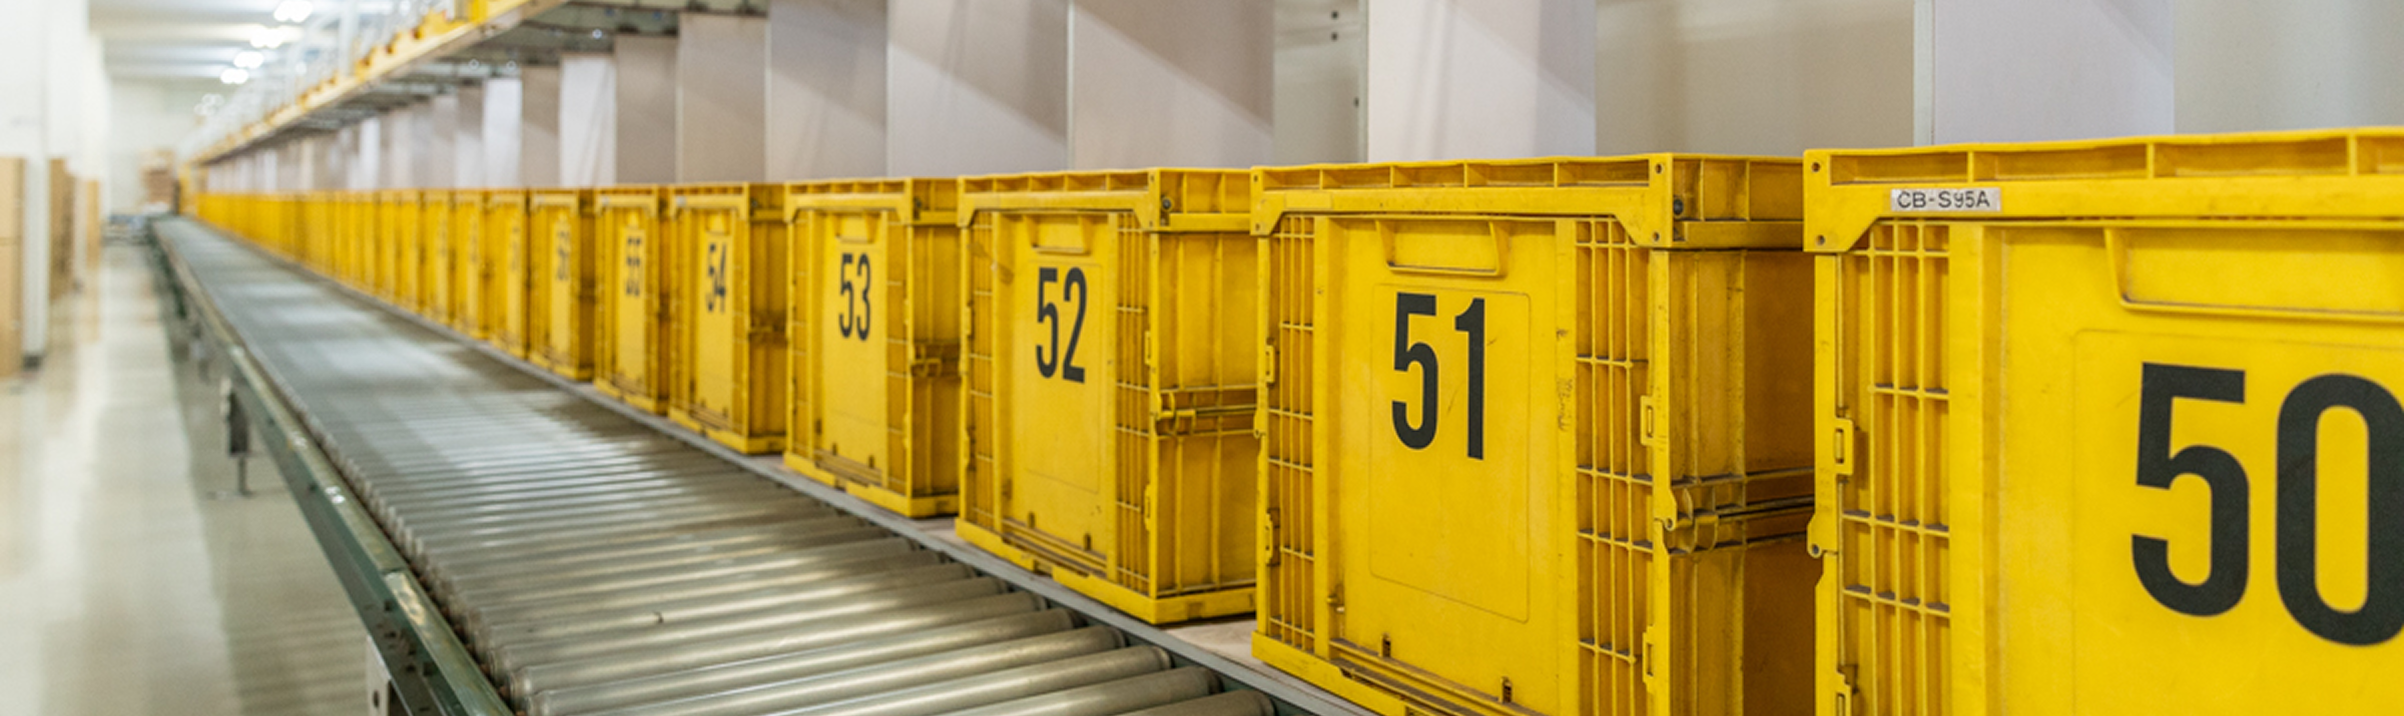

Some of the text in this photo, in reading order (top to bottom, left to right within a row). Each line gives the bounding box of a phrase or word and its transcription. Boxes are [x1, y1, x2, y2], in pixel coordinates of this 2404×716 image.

[1897, 190, 1990, 208] CB-S95A
[706, 243, 727, 313] 54
[840, 253, 870, 341] 53
[1036, 266, 1087, 384] 52
[1393, 292, 1485, 460] 51
[2132, 362, 2404, 646] 50
